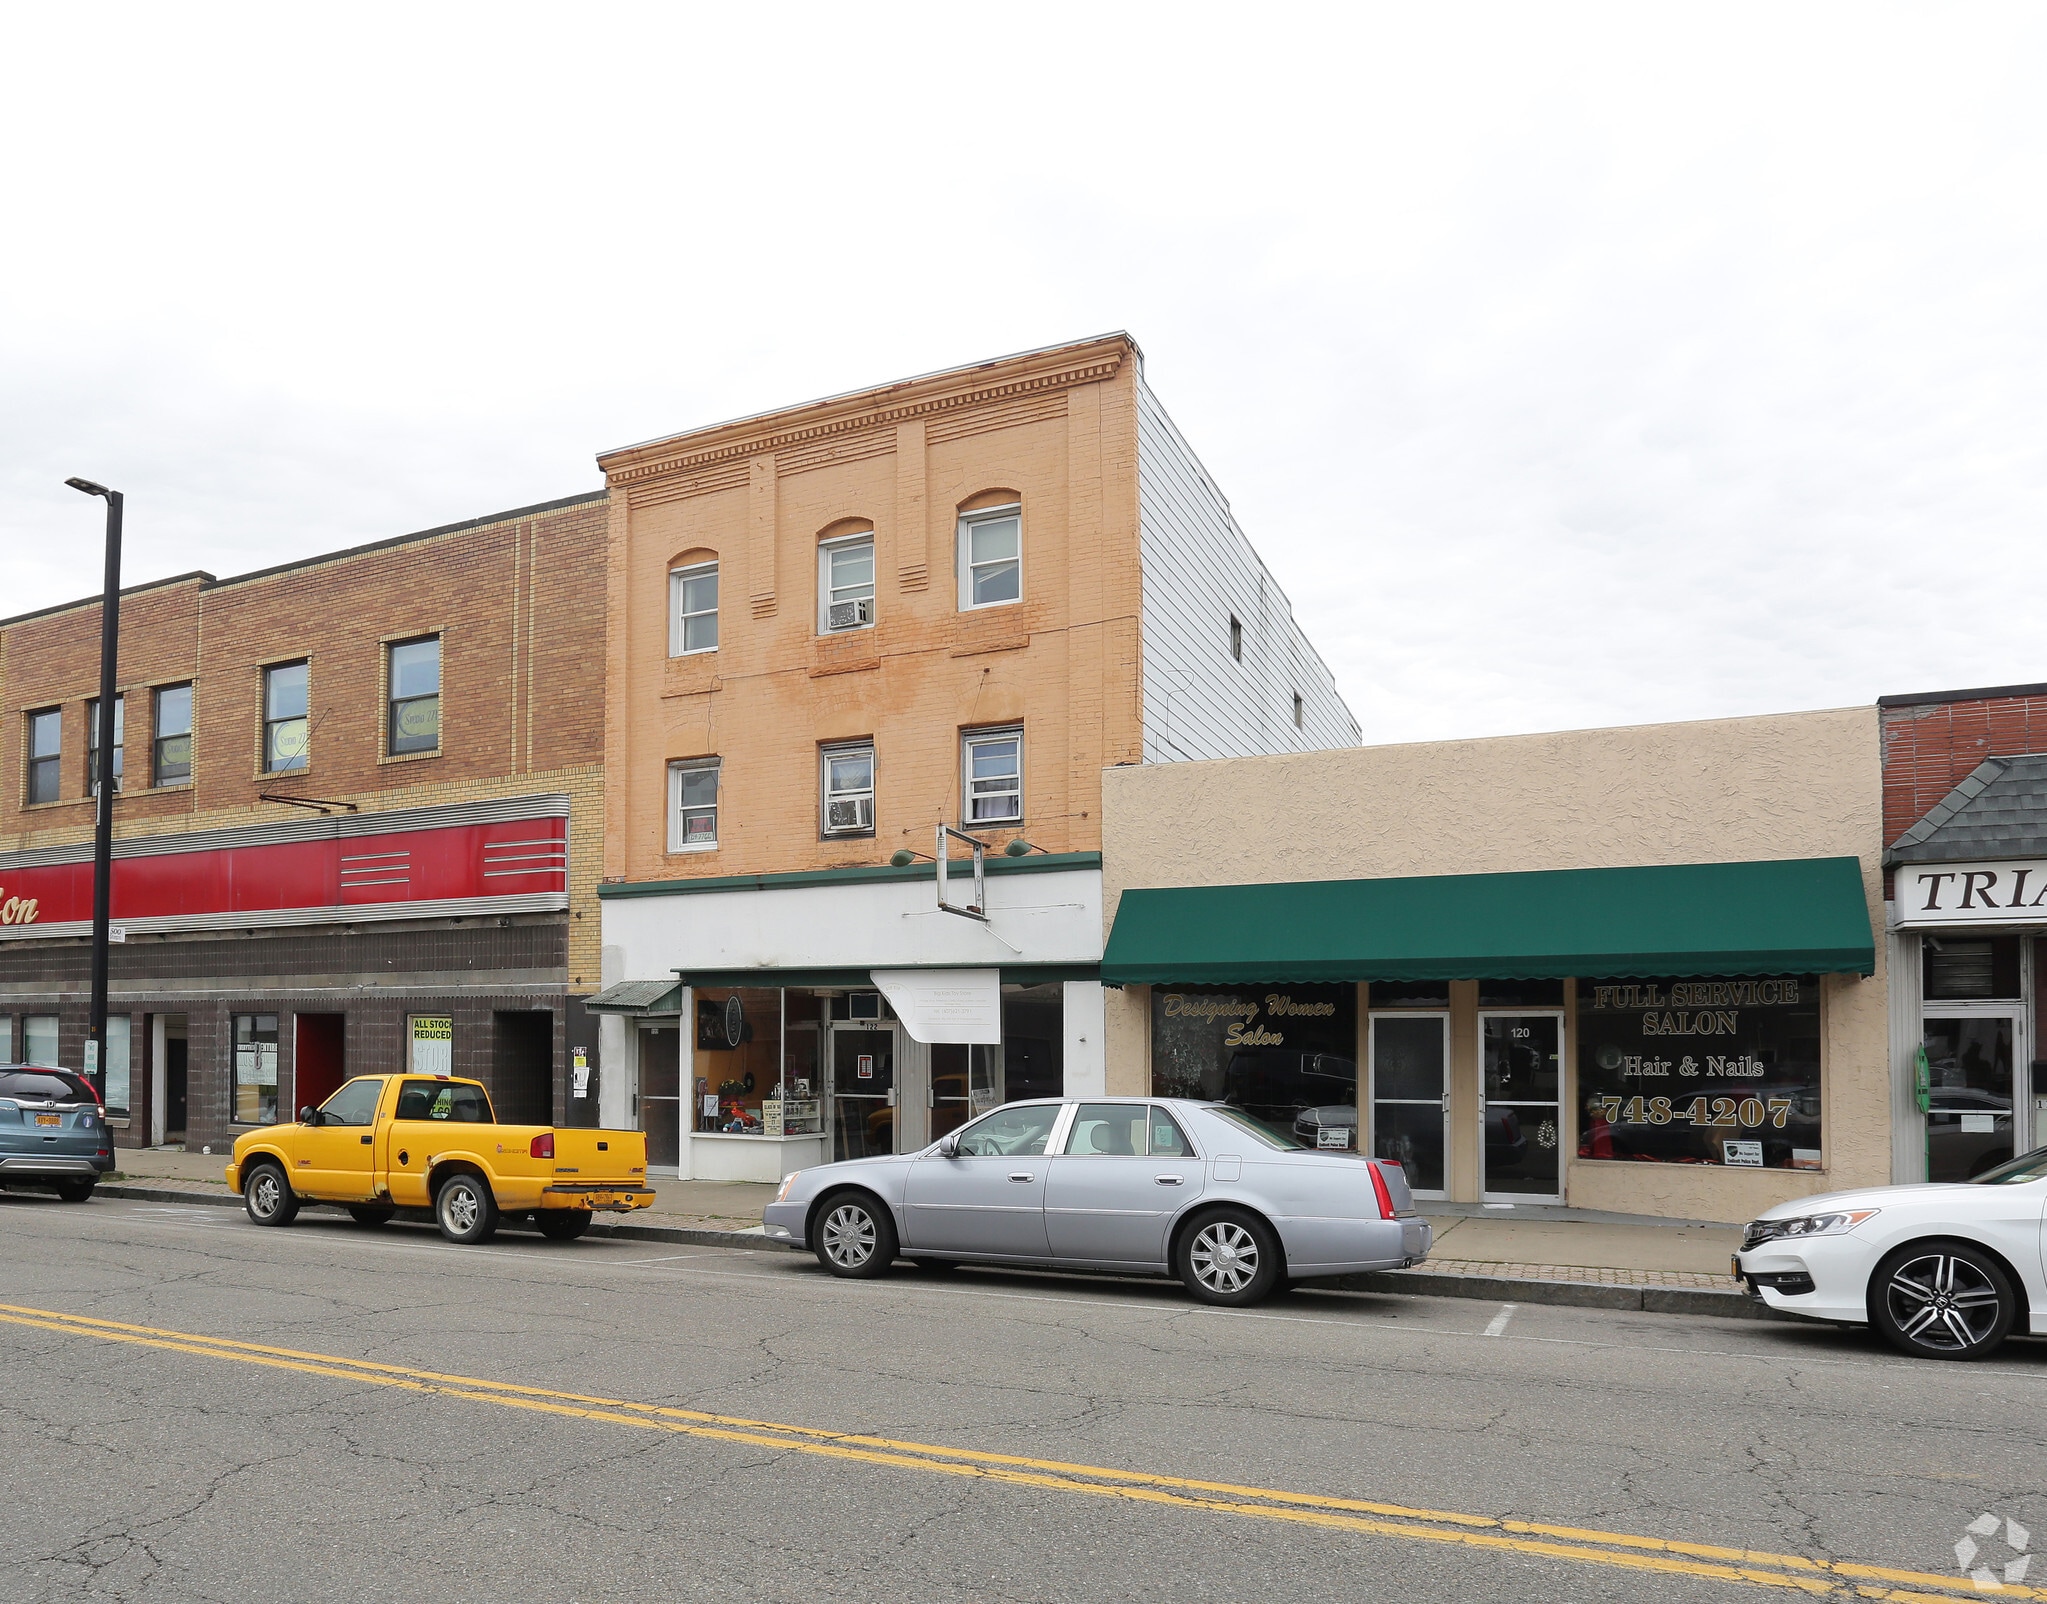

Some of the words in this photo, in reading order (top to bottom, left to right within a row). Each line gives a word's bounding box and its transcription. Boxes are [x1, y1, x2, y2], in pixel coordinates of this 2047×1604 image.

[1594, 984, 1665, 1008] FULL
[1671, 980, 1799, 1006] SERVICE
[1163, 993, 1259, 1024] Designing
[1265, 993, 1336, 1016] Women
[414, 1020, 429, 1029] ALL
[414, 1030, 451, 1039] REDUCED
[1225, 1023, 1284, 1046] Salon
[1511, 1028, 1530, 1038] 120
[1643, 1011, 1738, 1035] SALON
[1624, 1055, 1672, 1076] Hair
[1679, 1055, 1699, 1076] &
[1706, 1055, 1764, 1077] Nails
[1601, 1096, 1792, 1128] 748-4207
